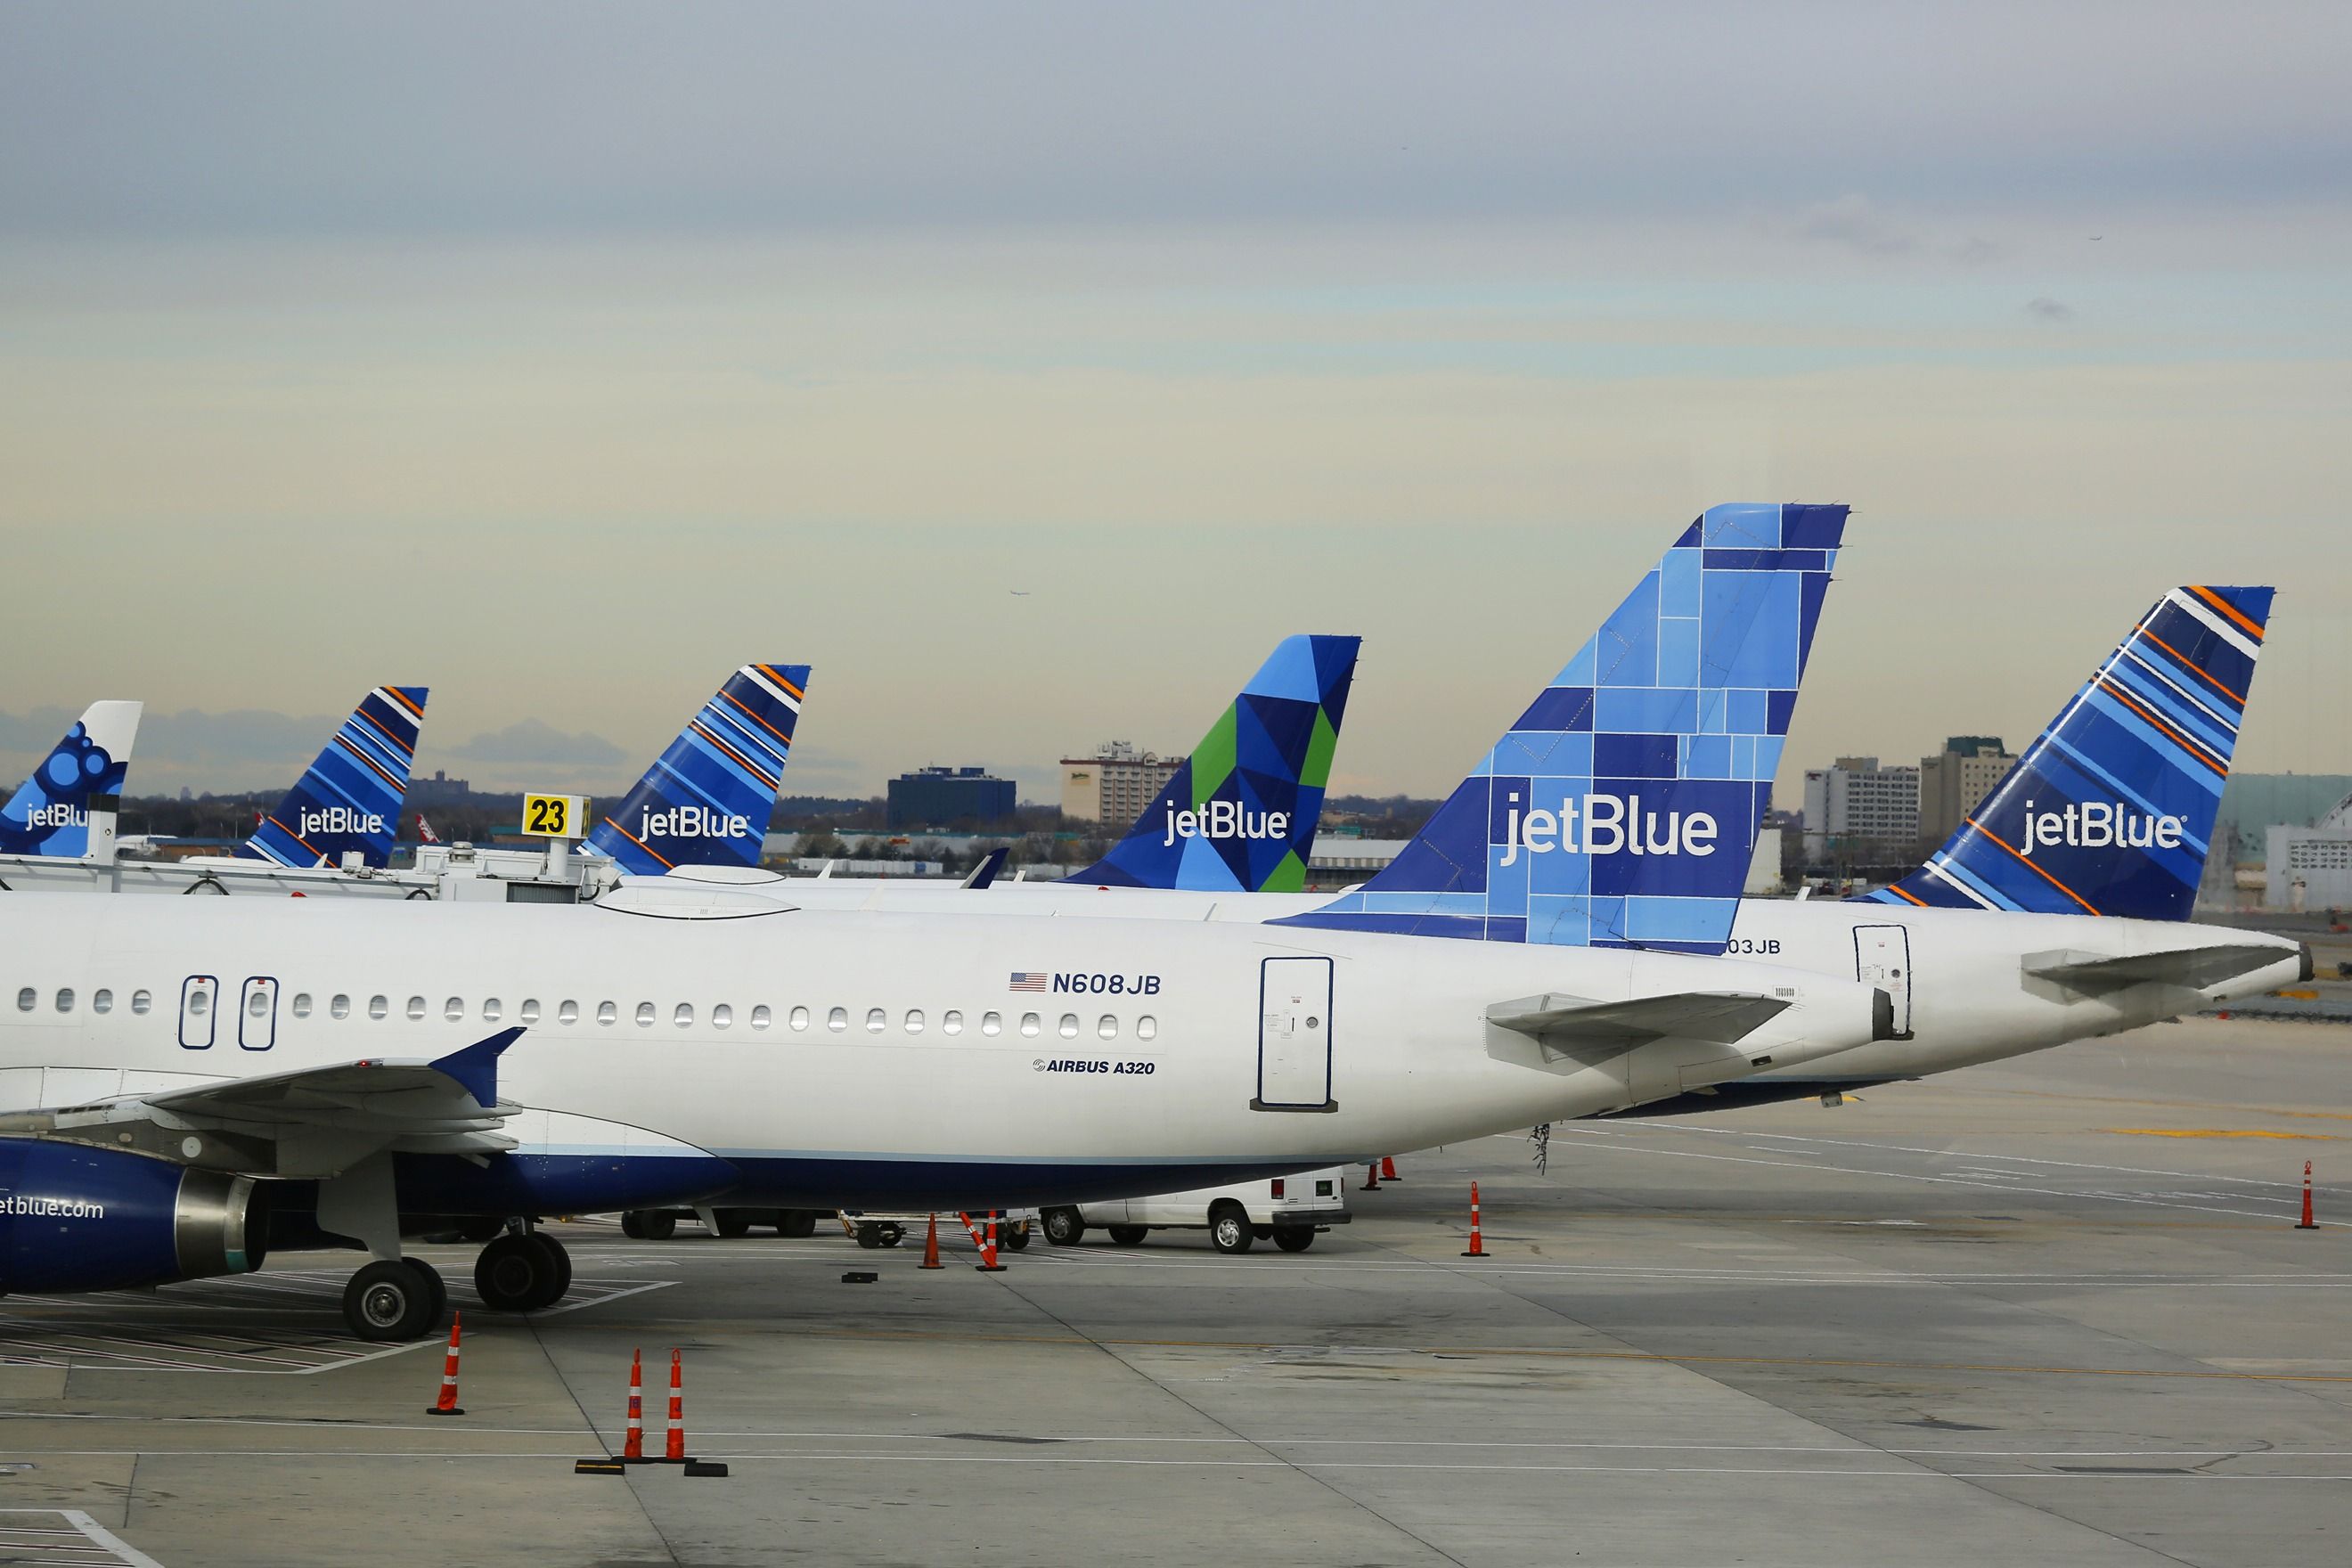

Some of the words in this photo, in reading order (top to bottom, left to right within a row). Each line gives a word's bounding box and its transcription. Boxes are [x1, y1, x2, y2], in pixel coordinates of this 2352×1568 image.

[26, 803, 88, 831] jetBlu
[298, 806, 382, 838] jetBlue
[529, 799, 565, 832] 23
[639, 805, 747, 843] jetBlue
[1164, 800, 1287, 846] jetBlue
[1500, 792, 1718, 867] jetBlue
[2020, 800, 2183, 856] jetBlue
[1729, 939, 1780, 954] 03JB
[1053, 973, 1161, 995] N608JB
[1047, 1059, 1109, 1074] AIRBUS
[1114, 1062, 1156, 1075] A320
[0, 1196, 103, 1219] etblue.com
